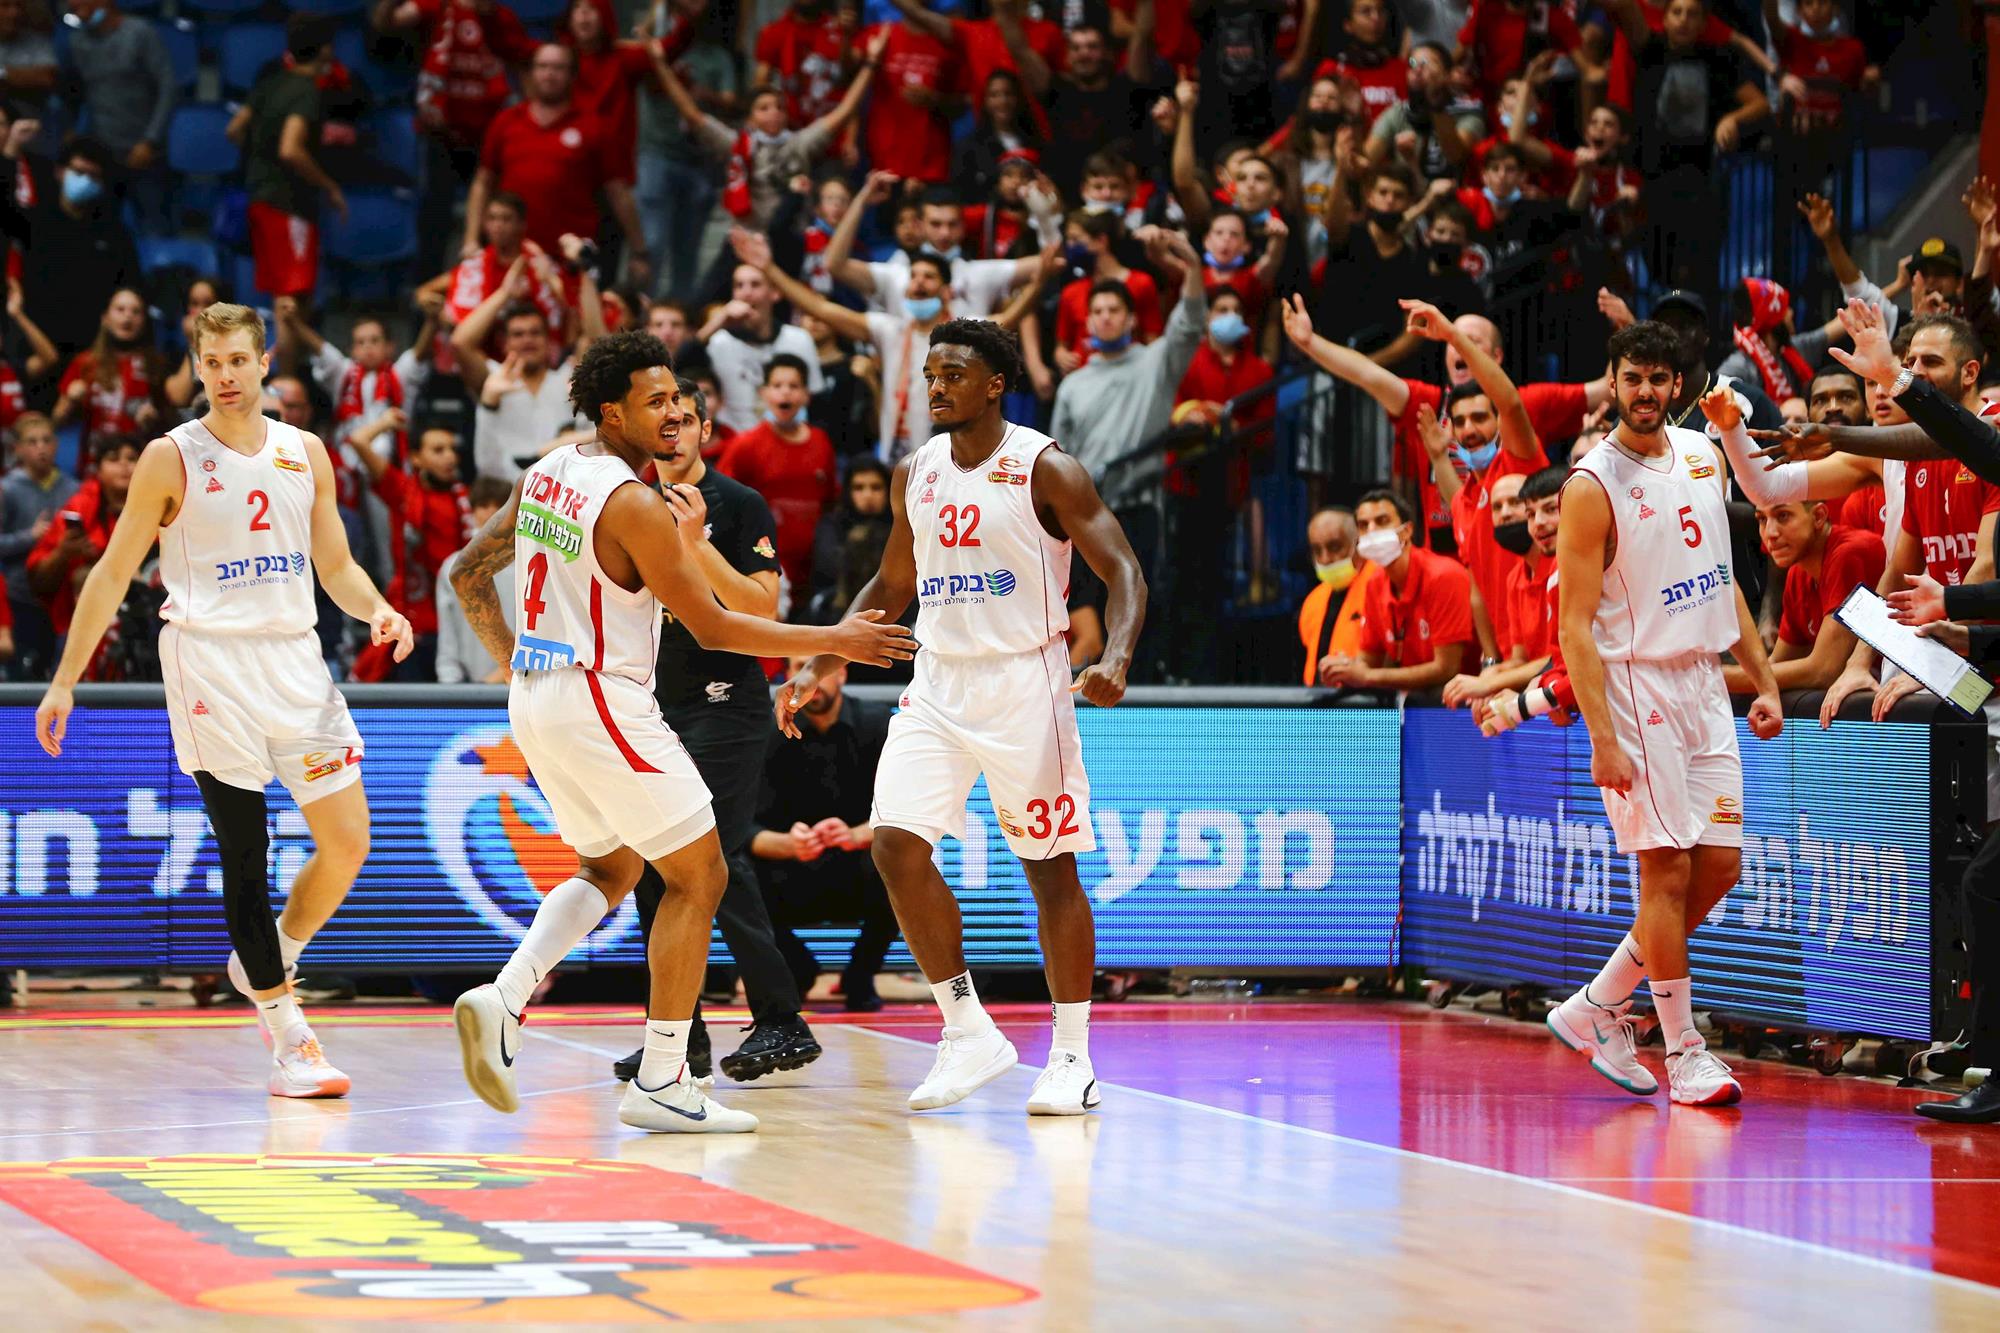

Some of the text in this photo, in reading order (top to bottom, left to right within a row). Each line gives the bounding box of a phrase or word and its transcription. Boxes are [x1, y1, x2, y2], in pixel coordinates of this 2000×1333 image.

[247, 490, 271, 532] 2
[938, 504, 981, 548] 32
[1678, 505, 1702, 548] 5
[216, 555, 289, 581] בנק יהב
[949, 574, 985, 596] בנק
[523, 552, 548, 631] 4
[1661, 578, 1696, 607] יהב
[1026, 793, 1079, 839] 32
[1417, 789, 1504, 922] לקהילה
[1799, 811, 1908, 954] מפעל
